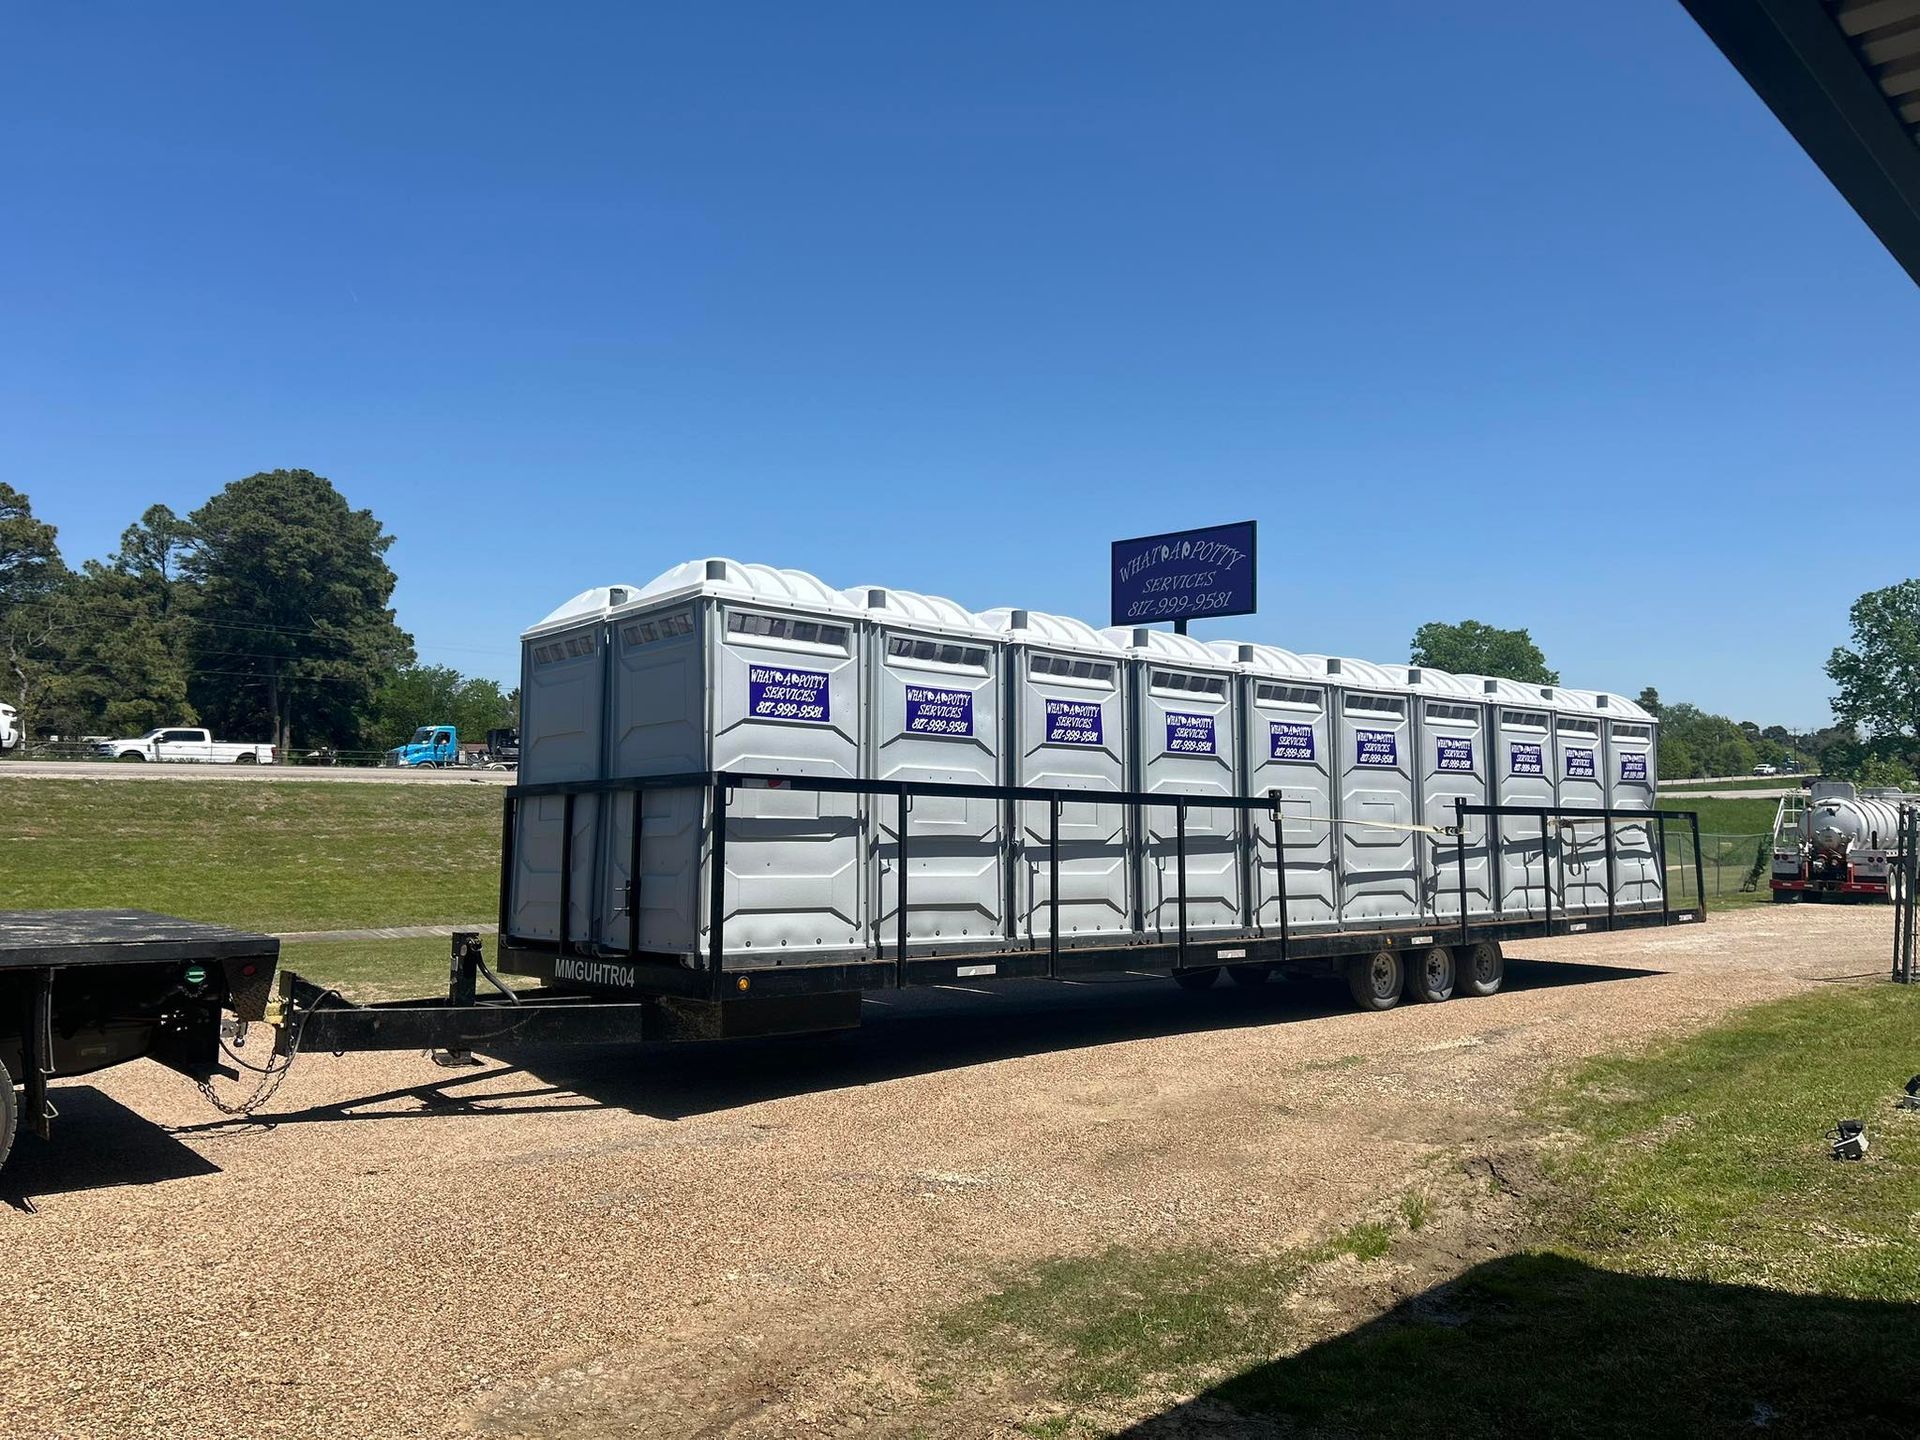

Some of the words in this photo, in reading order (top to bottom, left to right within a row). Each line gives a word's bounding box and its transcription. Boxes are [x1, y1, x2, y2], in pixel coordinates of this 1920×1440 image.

[1142, 570, 1217, 594] SERVICES
[1127, 591, 1232, 617] 817-999-9581
[763, 686, 817, 702] SERVICES
[756, 701, 824, 718] 817-999-9581
[918, 704, 963, 718] SERVICES
[912, 718, 968, 733] 817-999-9581
[1056, 716, 1093, 729] SERVICES
[1175, 727, 1208, 739] SERVICES
[554, 958, 636, 988] MMGUHTR04
